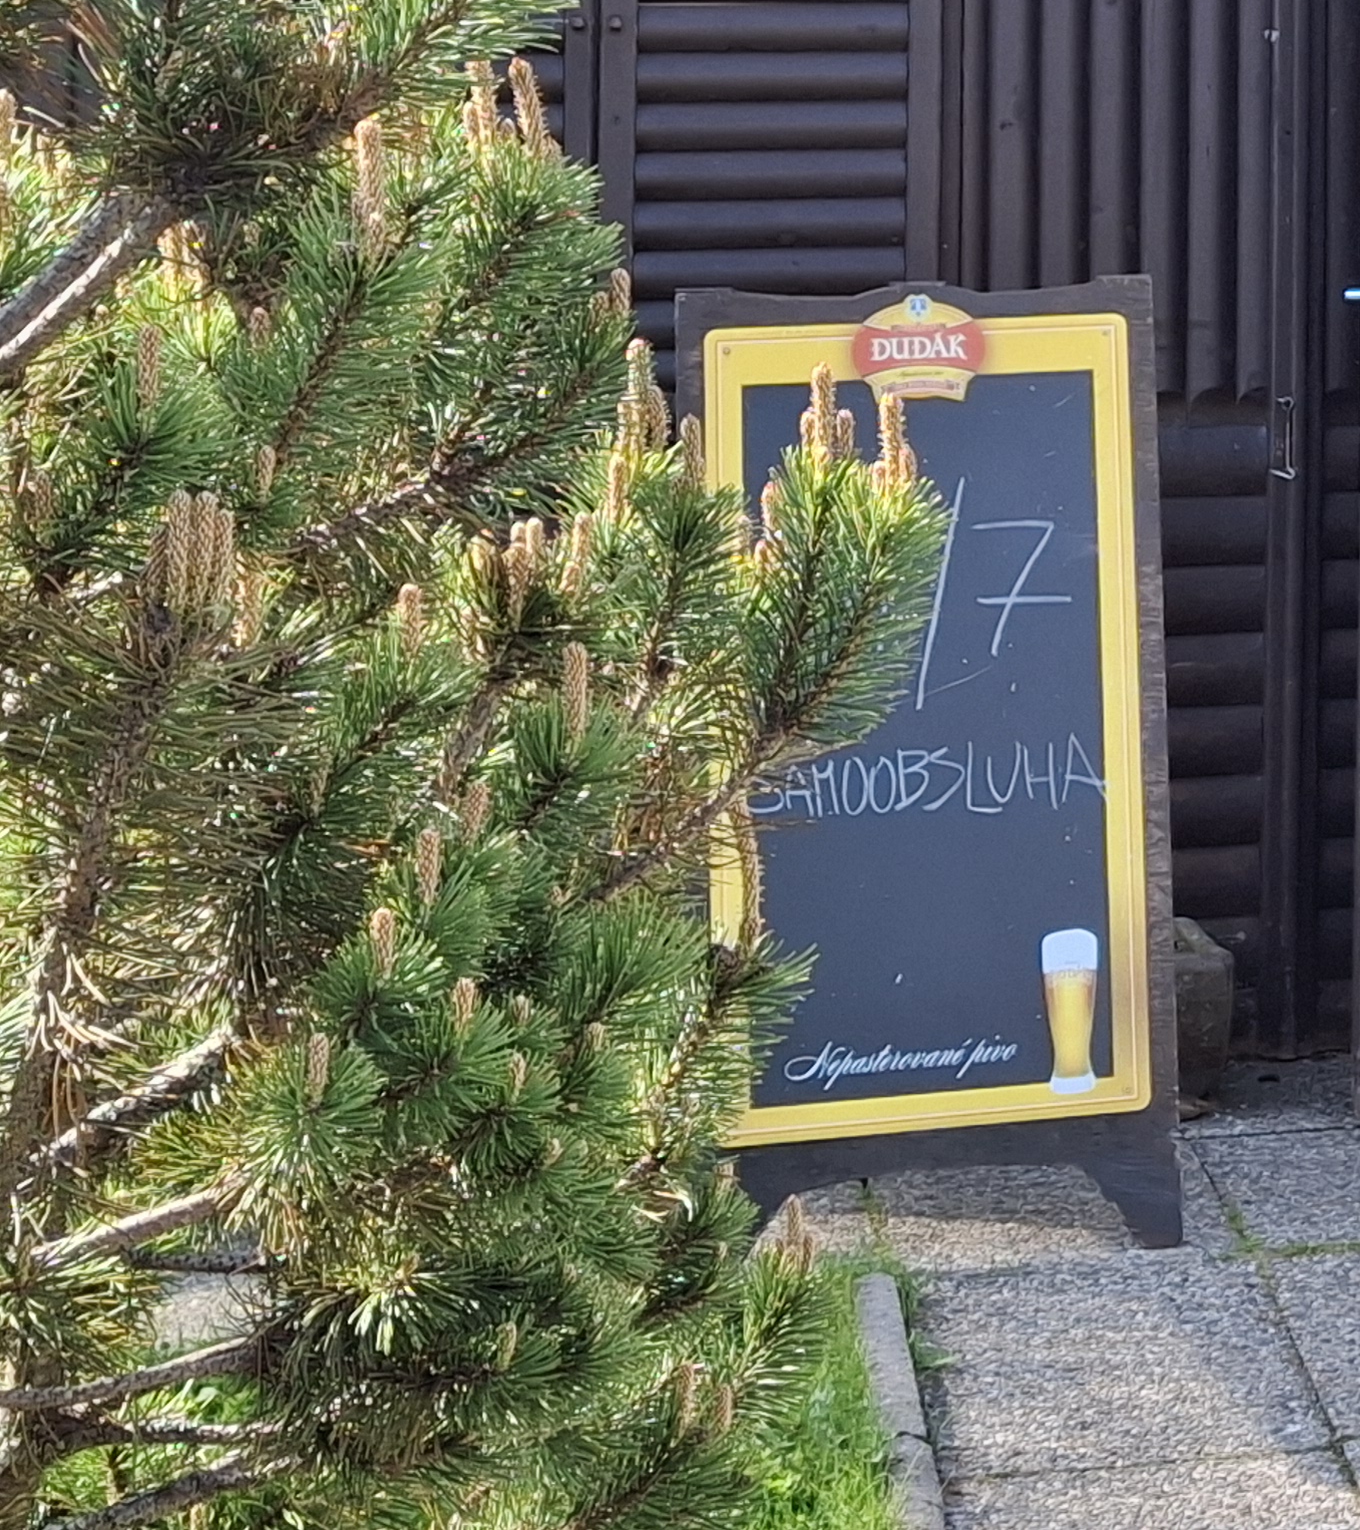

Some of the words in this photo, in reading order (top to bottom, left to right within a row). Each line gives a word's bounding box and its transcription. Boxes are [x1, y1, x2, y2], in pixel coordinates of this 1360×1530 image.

[870, 331, 968, 361] DUDÁK
[784, 1041, 973, 1092] Nepasterované
[955, 1034, 1019, 1080] pivo
